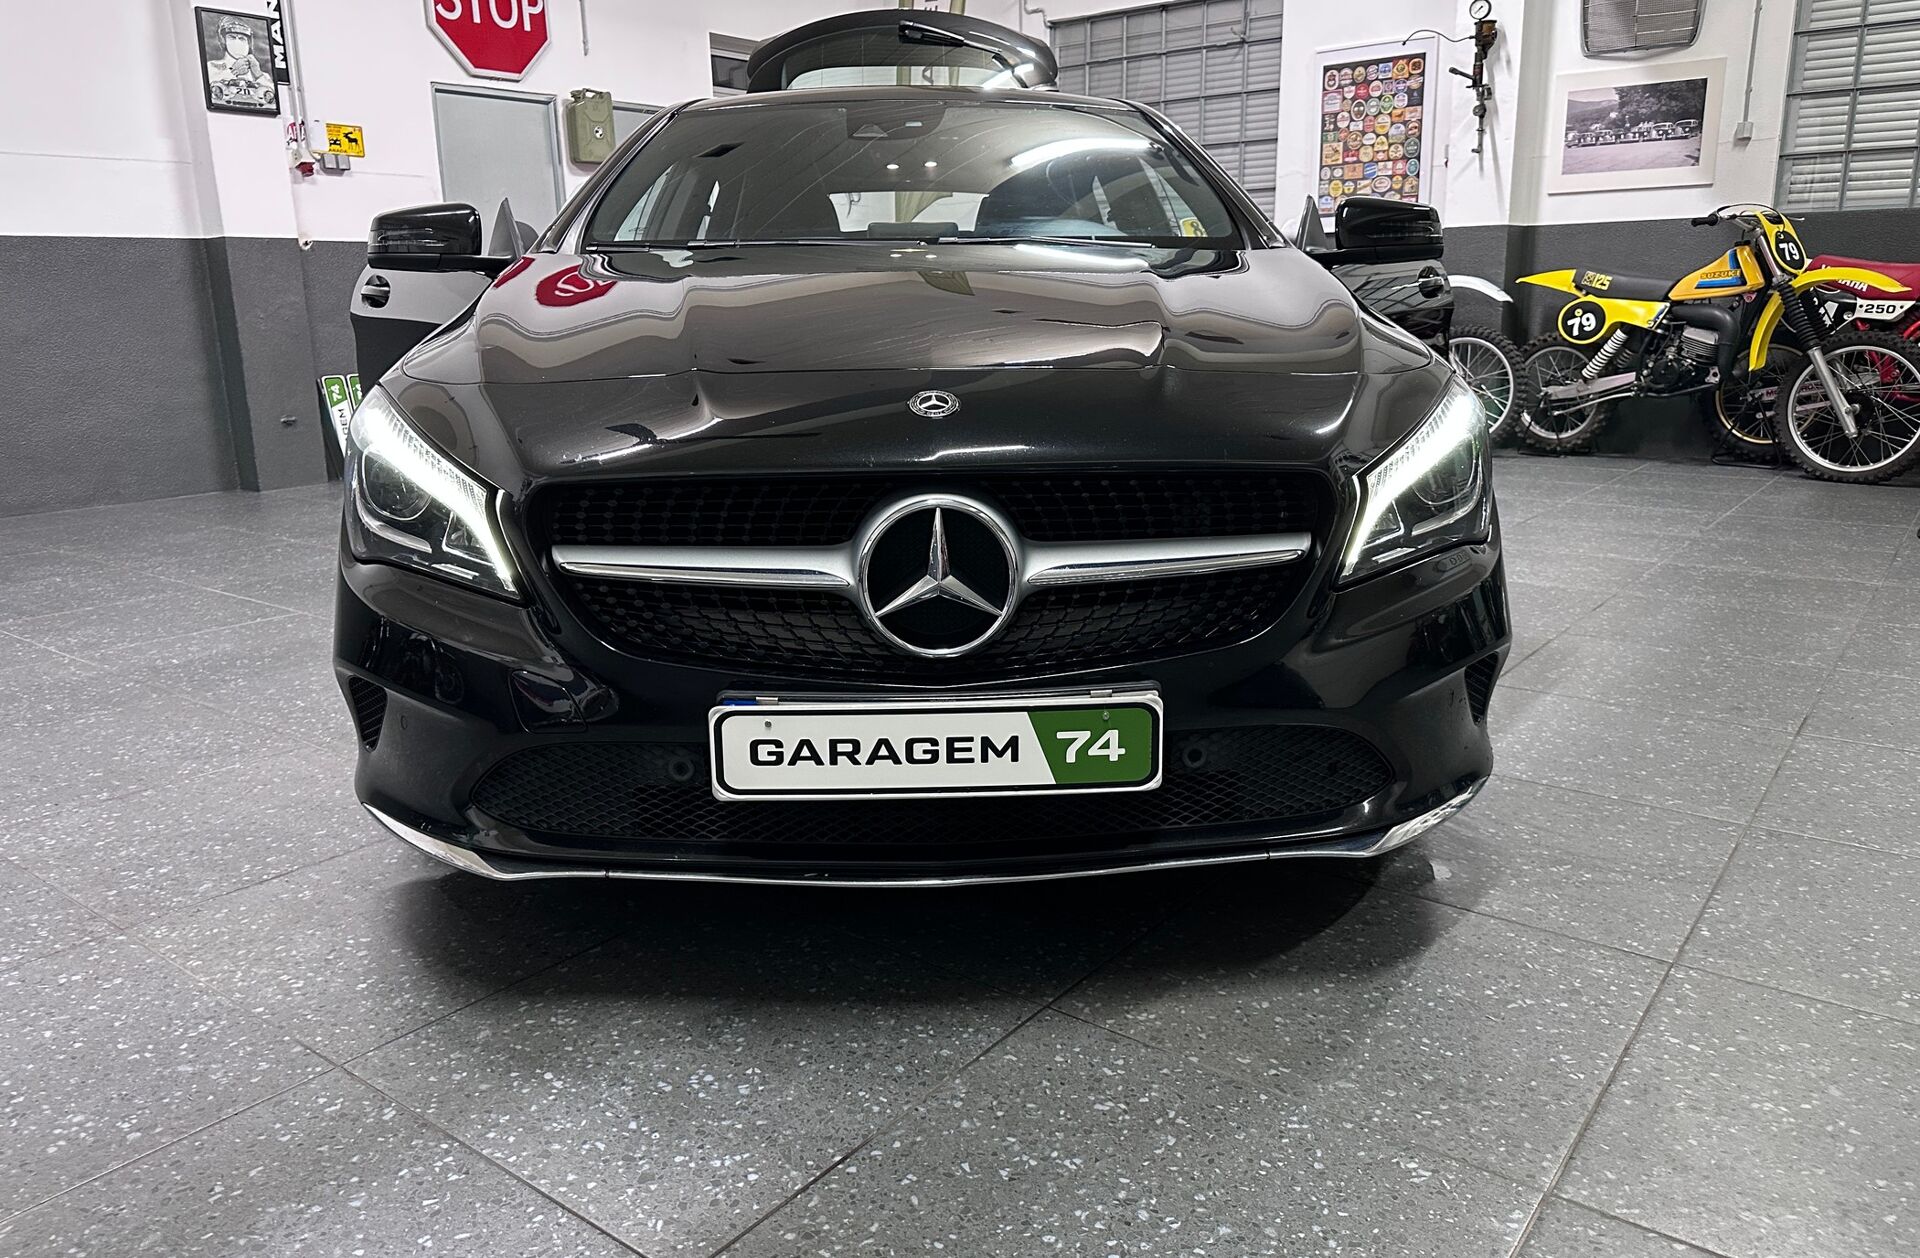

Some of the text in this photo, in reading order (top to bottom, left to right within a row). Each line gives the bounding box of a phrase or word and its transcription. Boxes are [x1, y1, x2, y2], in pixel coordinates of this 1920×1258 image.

[1779, 242, 1800, 261] 79
[1592, 273, 1613, 290] 125
[1700, 269, 1741, 279] SUZUKI
[1864, 304, 1896, 314] 250
[1567, 312, 1597, 336] 79
[749, 729, 1126, 767] GARAGEM 74
